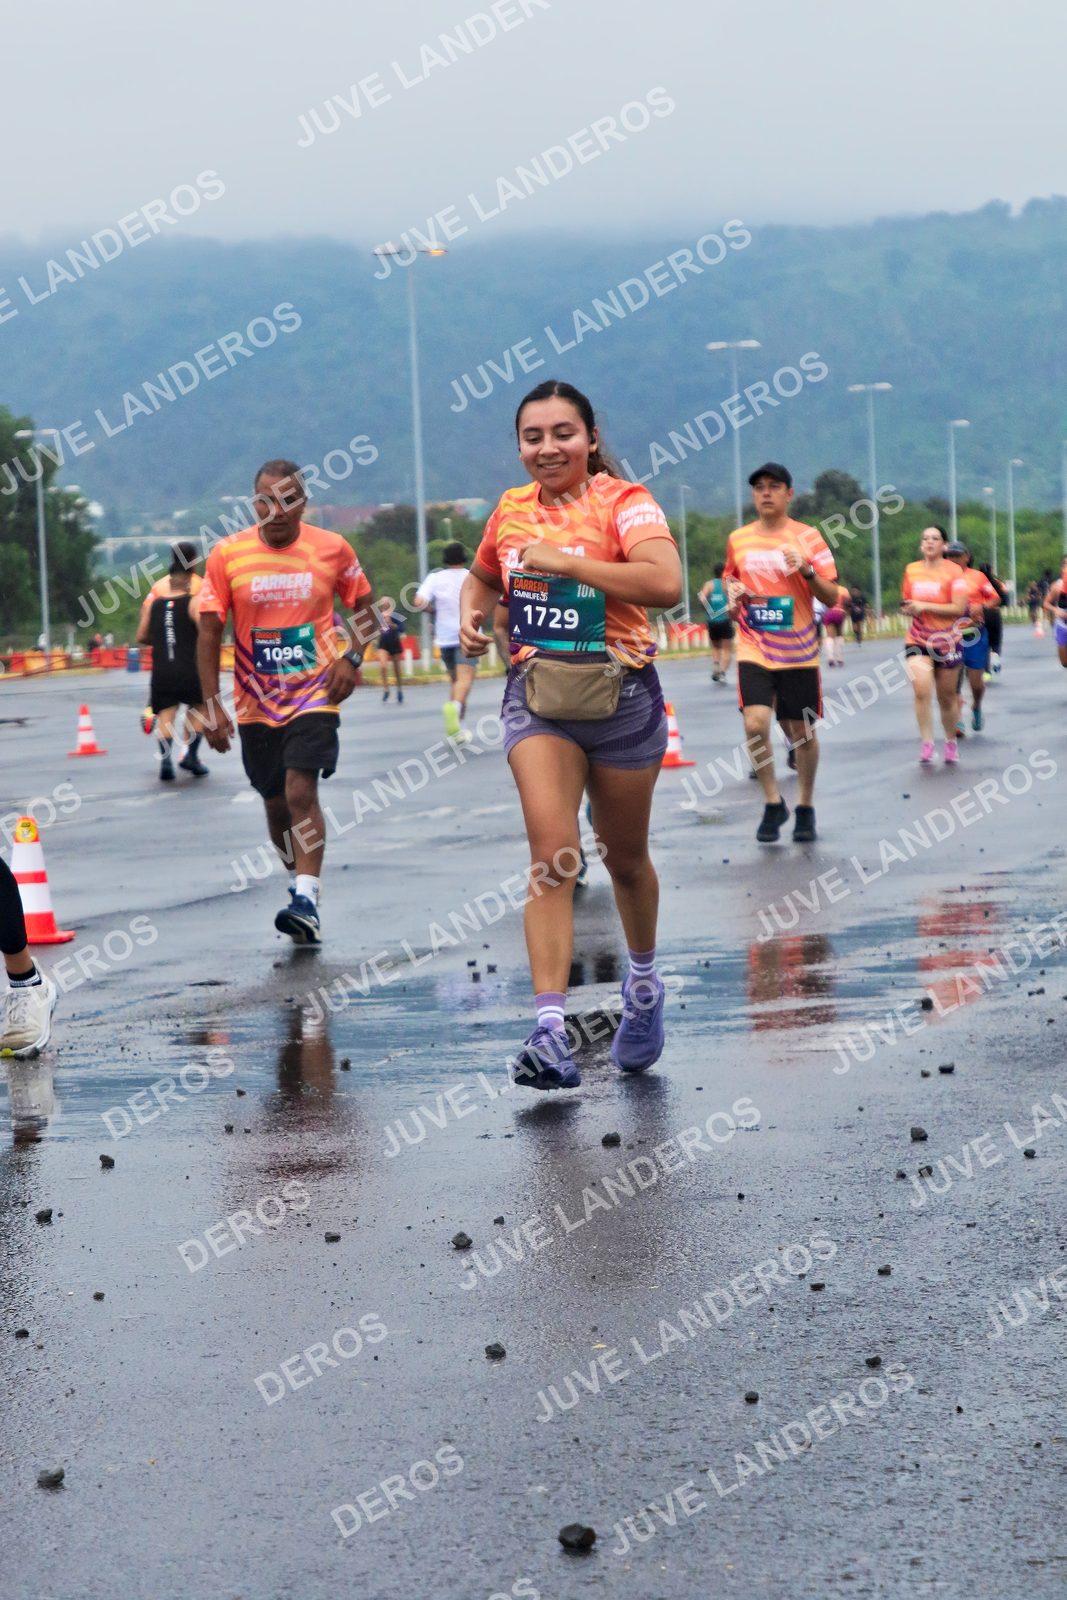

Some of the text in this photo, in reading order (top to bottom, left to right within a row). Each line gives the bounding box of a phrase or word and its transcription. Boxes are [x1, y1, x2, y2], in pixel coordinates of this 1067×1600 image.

[513, 577, 549, 593] CARRERA
[577, 583, 596, 598] 10K
[523, 604, 579, 630] 1729
[754, 609, 784, 621] 1295
[263, 644, 304, 662] 1096
